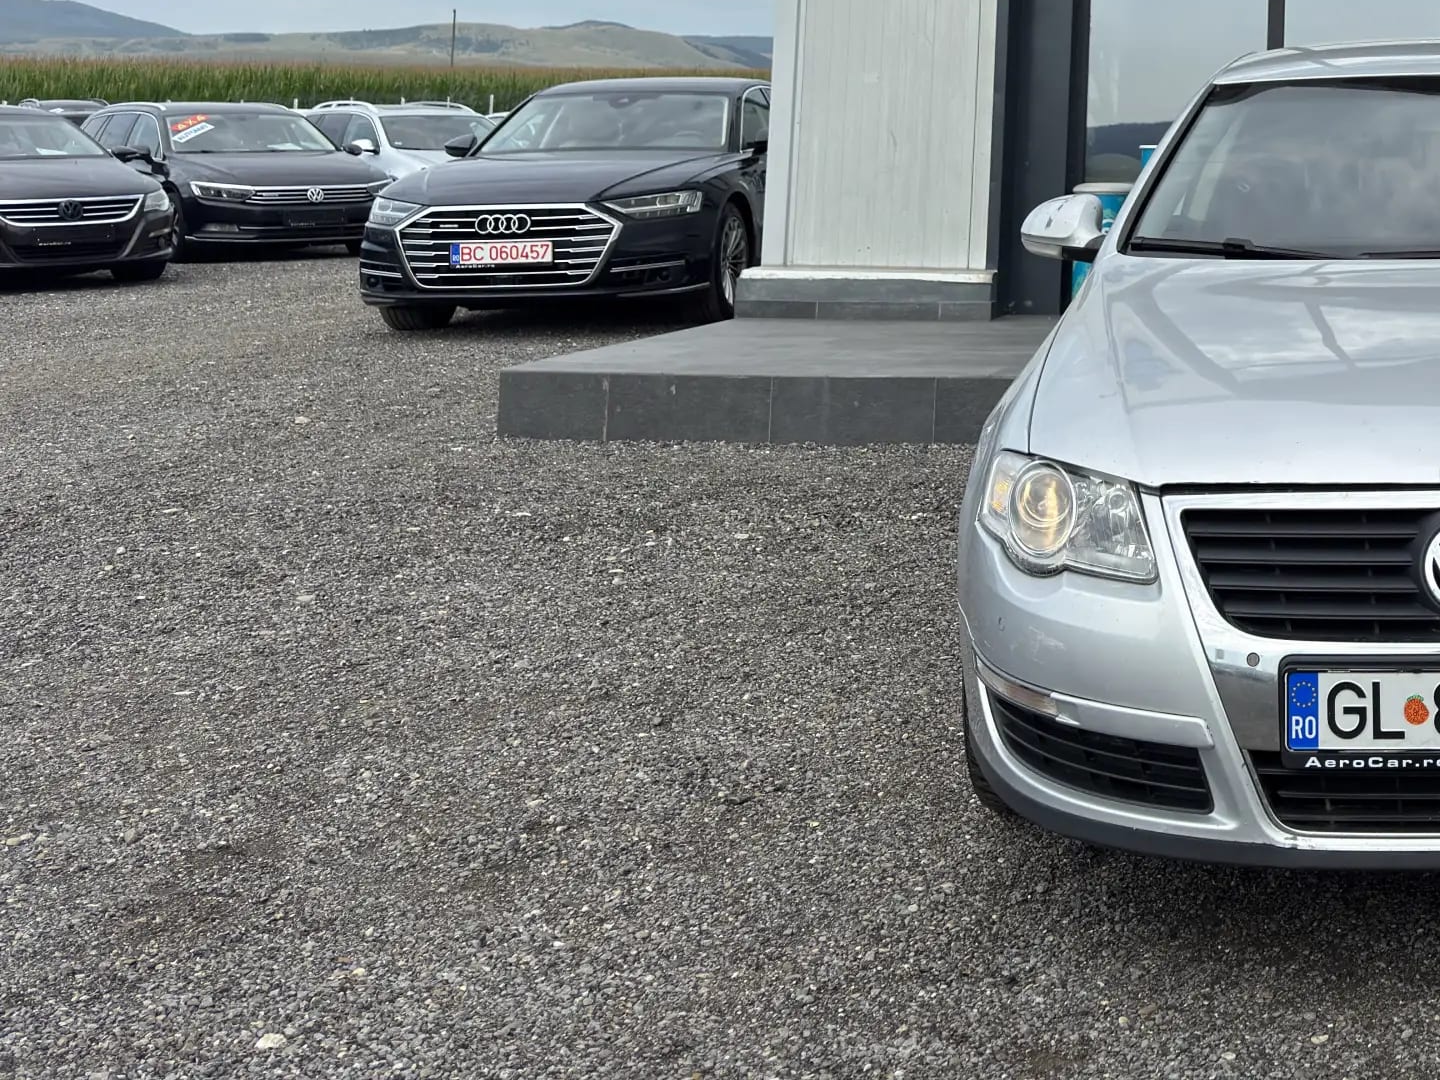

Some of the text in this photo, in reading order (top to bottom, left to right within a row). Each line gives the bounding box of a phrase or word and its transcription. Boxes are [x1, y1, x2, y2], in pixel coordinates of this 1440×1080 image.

[461, 243, 550, 262] BC 060457
[1327, 681, 1405, 739] GL
[1291, 716, 1317, 739] RO
